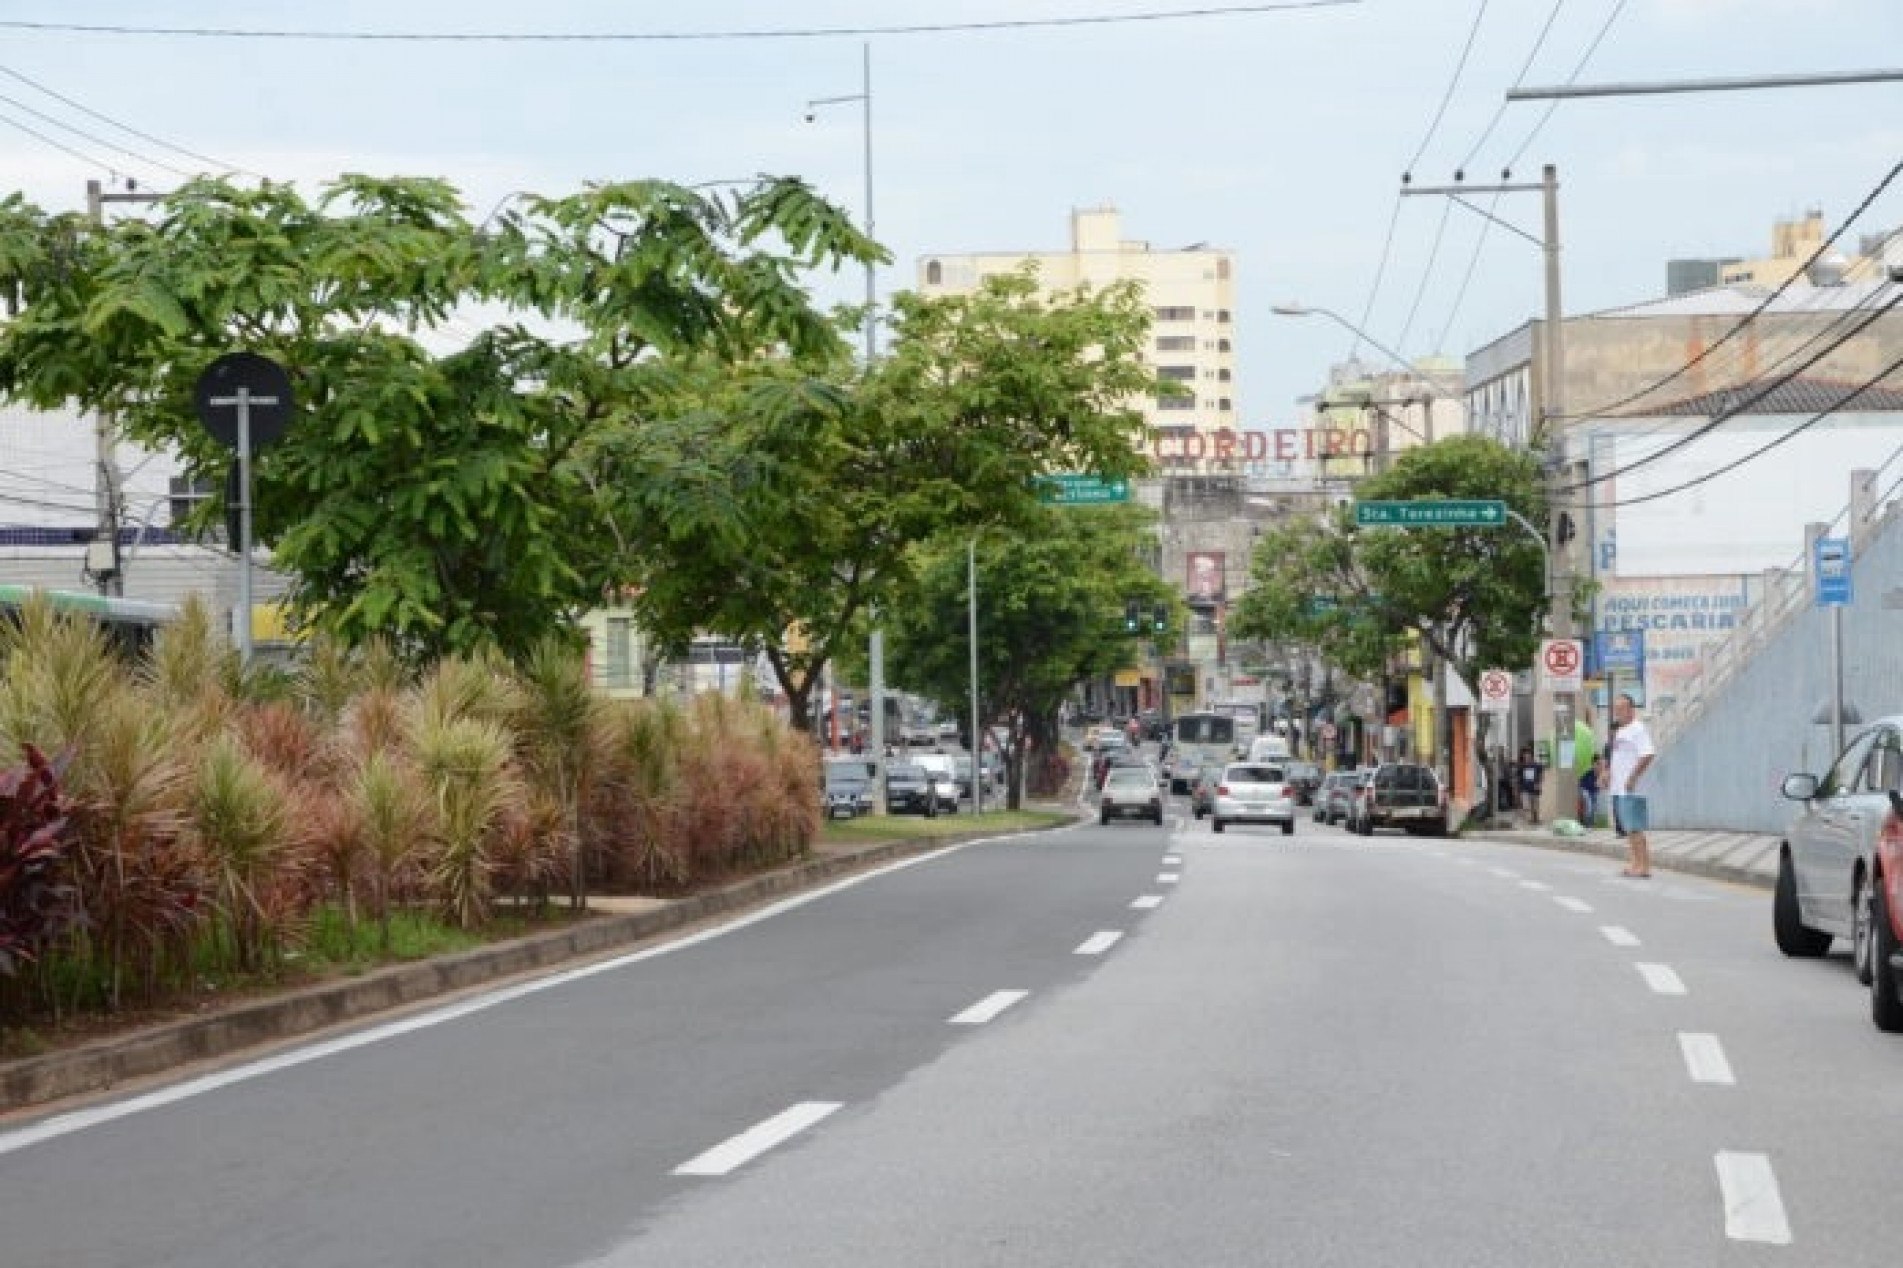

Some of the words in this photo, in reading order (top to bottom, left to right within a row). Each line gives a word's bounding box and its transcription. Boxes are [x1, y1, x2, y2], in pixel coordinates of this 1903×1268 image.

[1153, 428, 1371, 460] CORDEIRO
[1399, 507, 1477, 520] Terezinha
[1605, 596, 1649, 612] AQUI
[1605, 614, 1734, 630] PESCARIA
